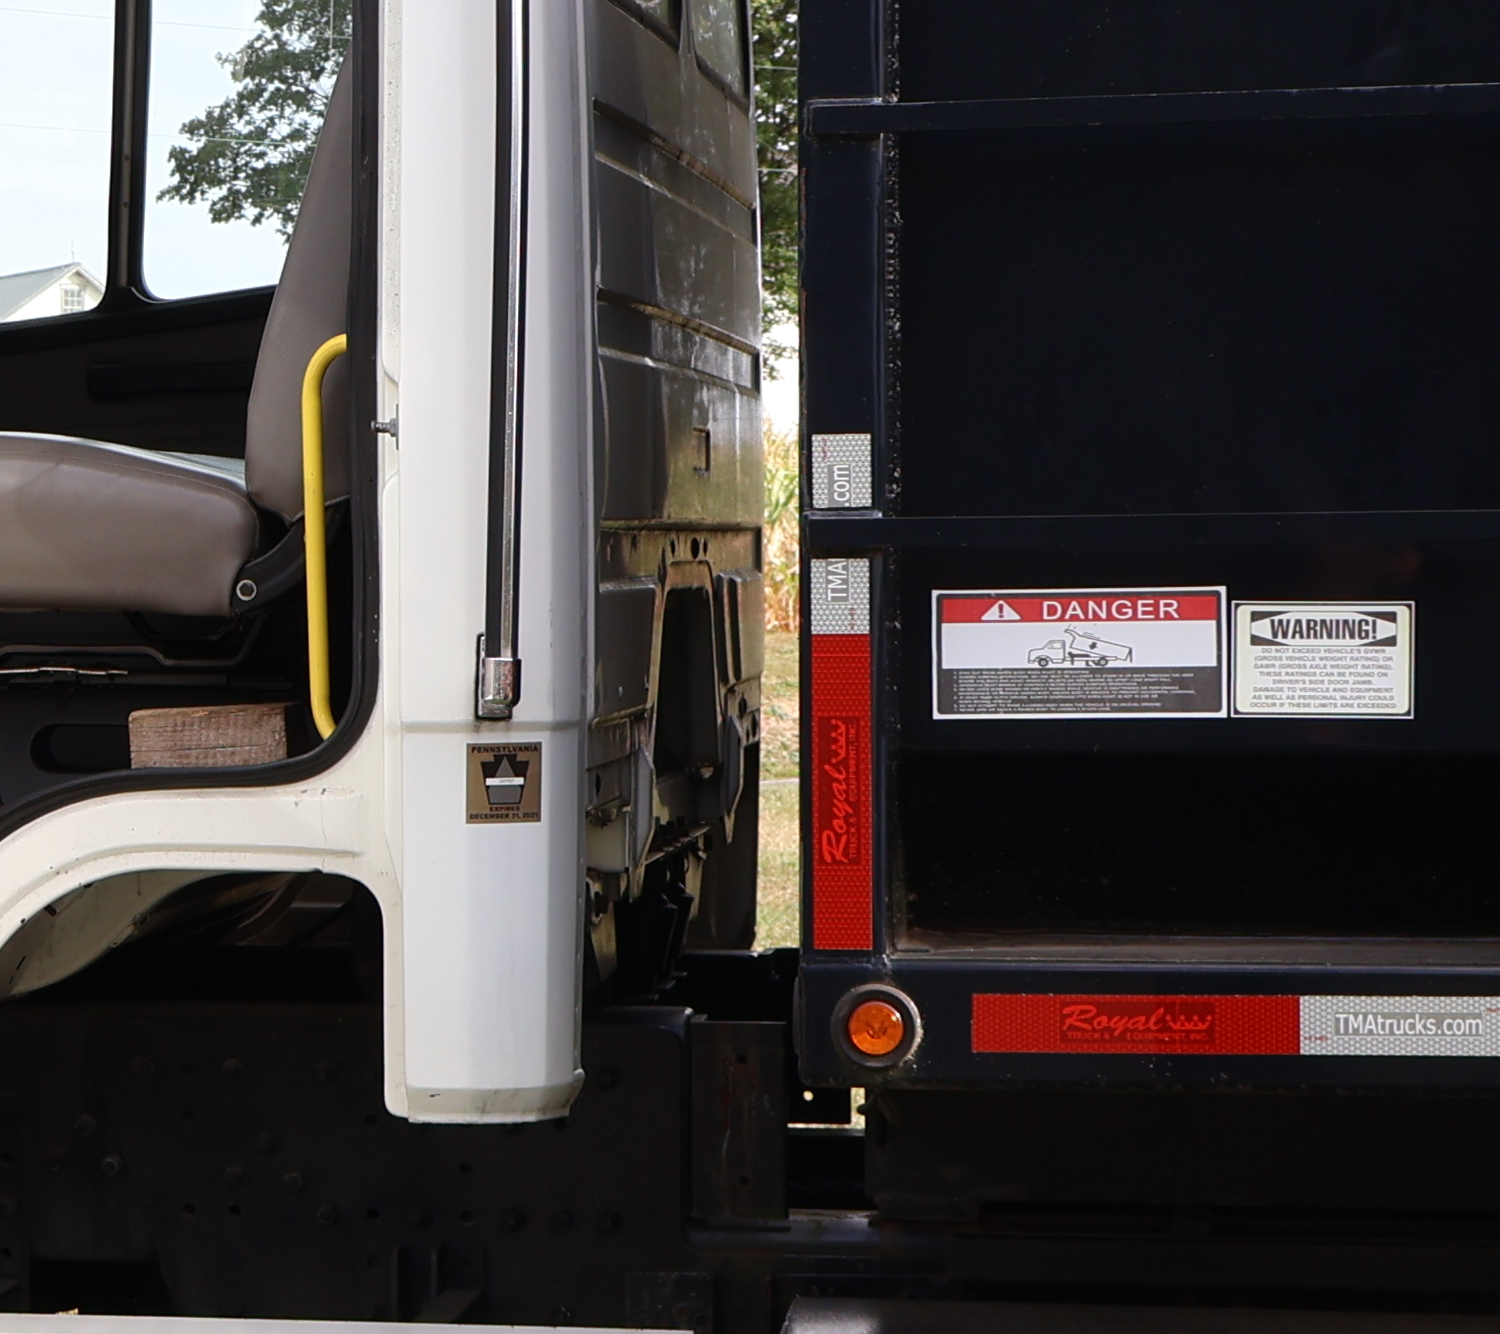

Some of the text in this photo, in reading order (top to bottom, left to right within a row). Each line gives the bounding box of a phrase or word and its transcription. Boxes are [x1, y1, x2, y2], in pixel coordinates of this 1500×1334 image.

[1042, 599, 1180, 620] DANGER
[1269, 618, 1378, 640] WARNING!
[471, 745, 538, 753] PENNSYLVANIA
[822, 764, 853, 863] Royal
[1062, 1005, 1165, 1037] Royal
[1335, 1013, 1483, 1035] TMAtrucks.com
